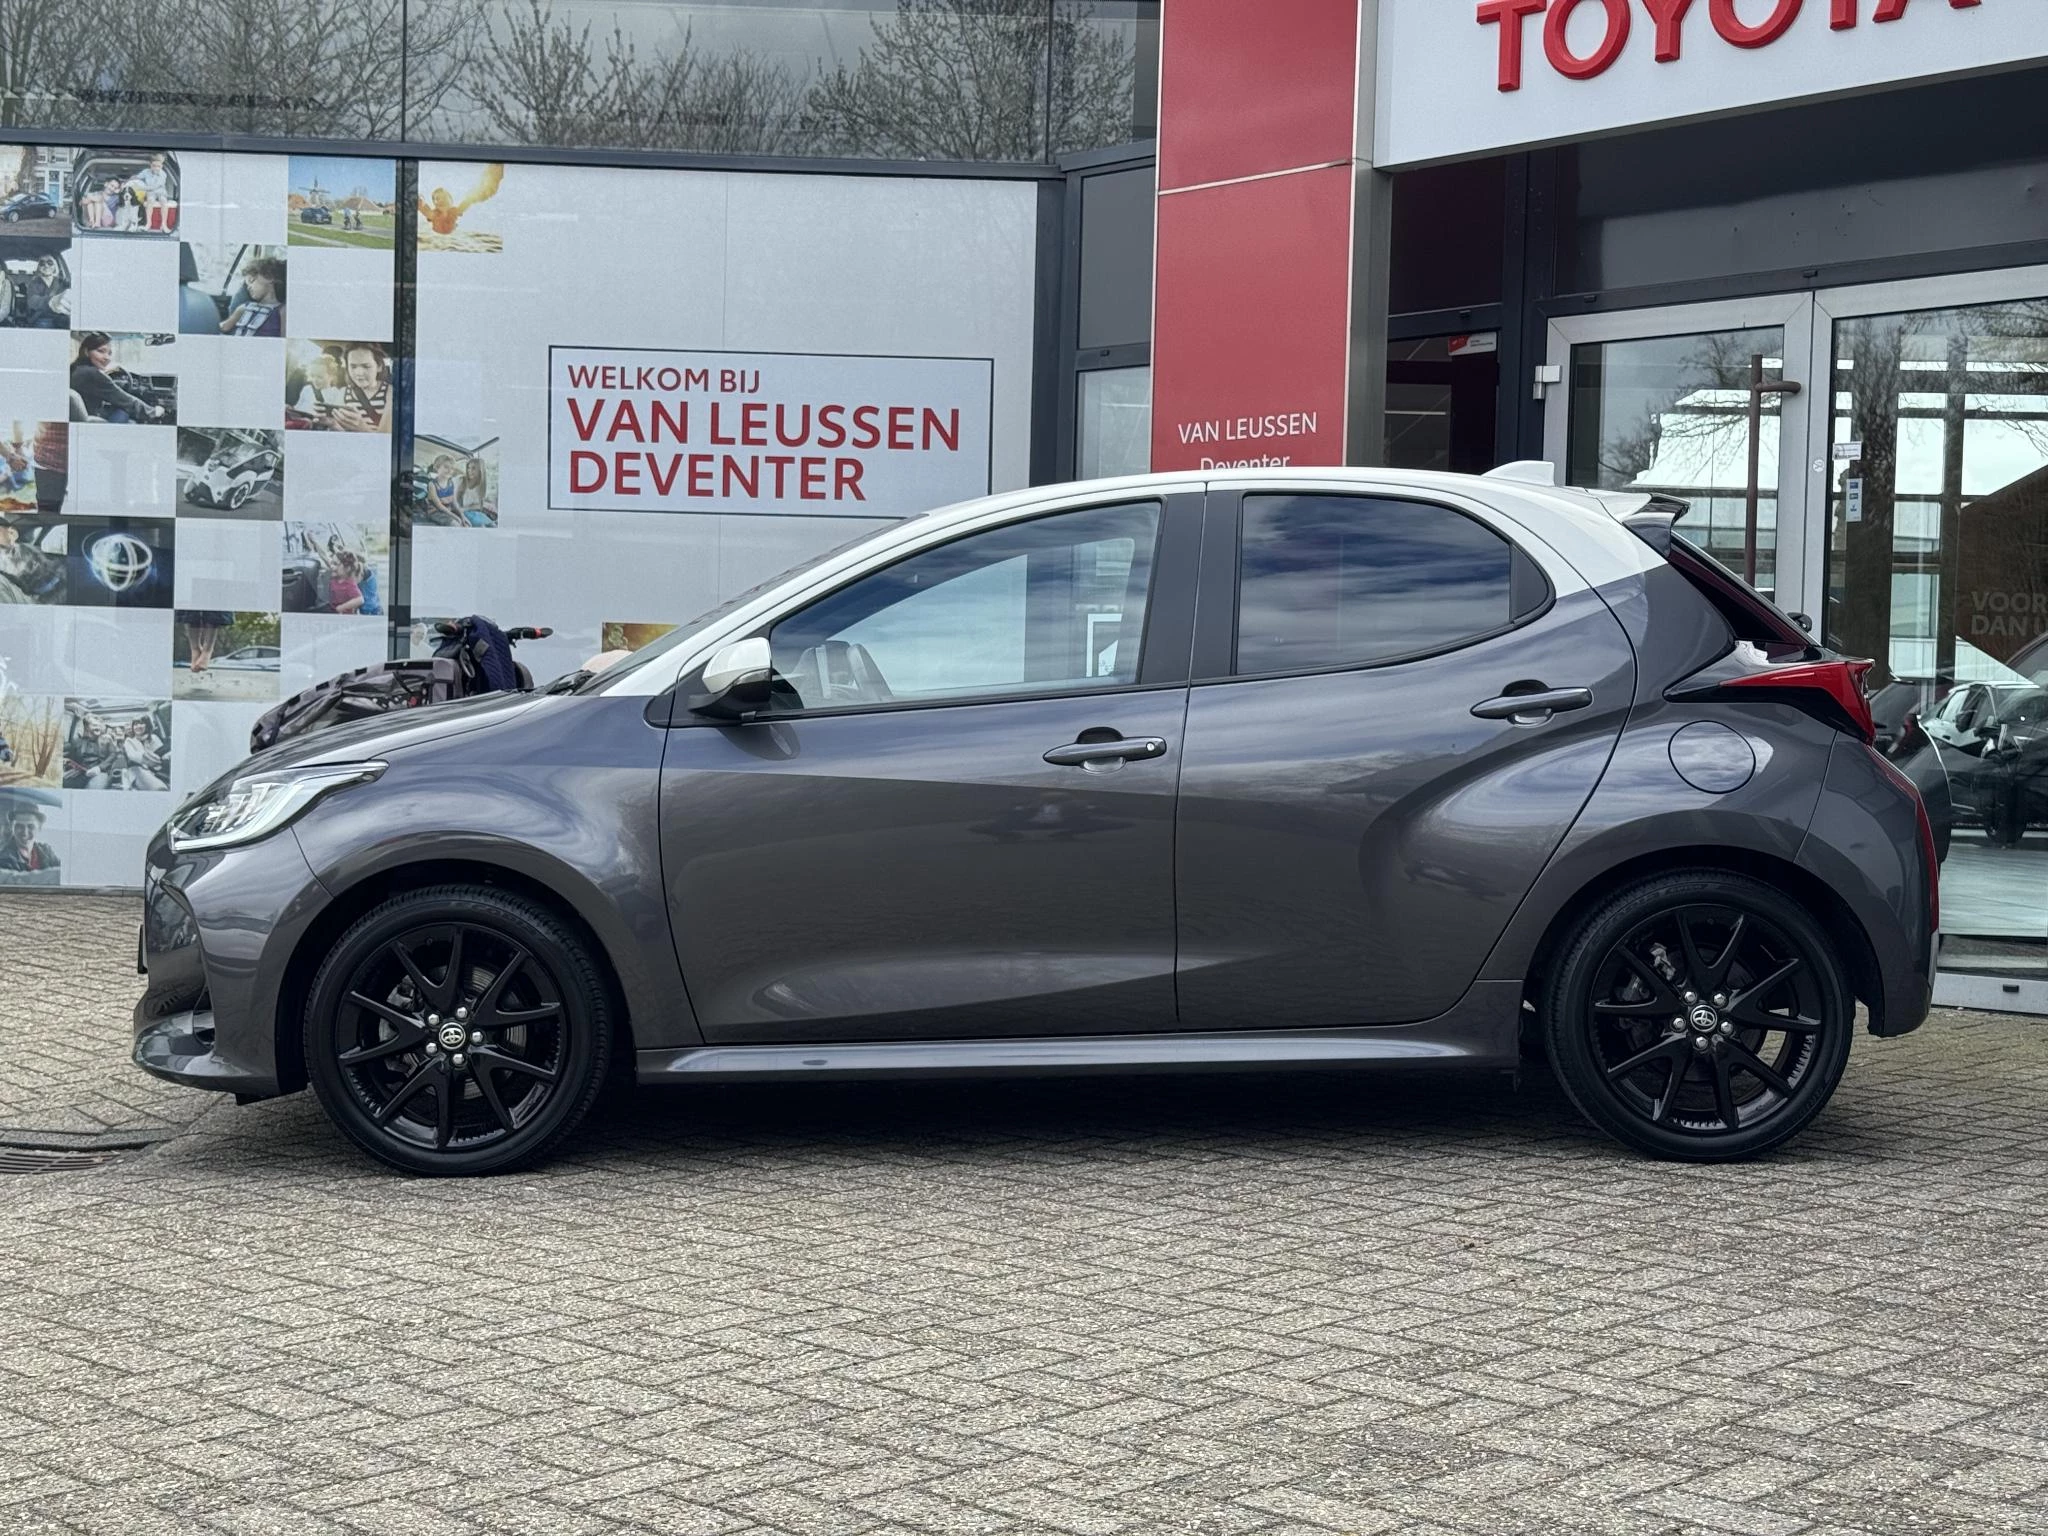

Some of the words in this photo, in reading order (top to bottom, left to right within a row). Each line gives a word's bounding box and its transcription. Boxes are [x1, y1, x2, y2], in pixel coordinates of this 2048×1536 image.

[1476, 0, 1981, 92] TOYO
[567, 364, 710, 393] WELKOM
[719, 369, 761, 394] BIJ
[566, 397, 689, 445] VAN
[710, 401, 960, 452] LEUSSEN
[1177, 420, 1220, 444] VAN
[1225, 411, 1317, 441] LEUSSEN
[569, 450, 867, 501] DEVENTER
[1970, 614, 2029, 637] DAN
